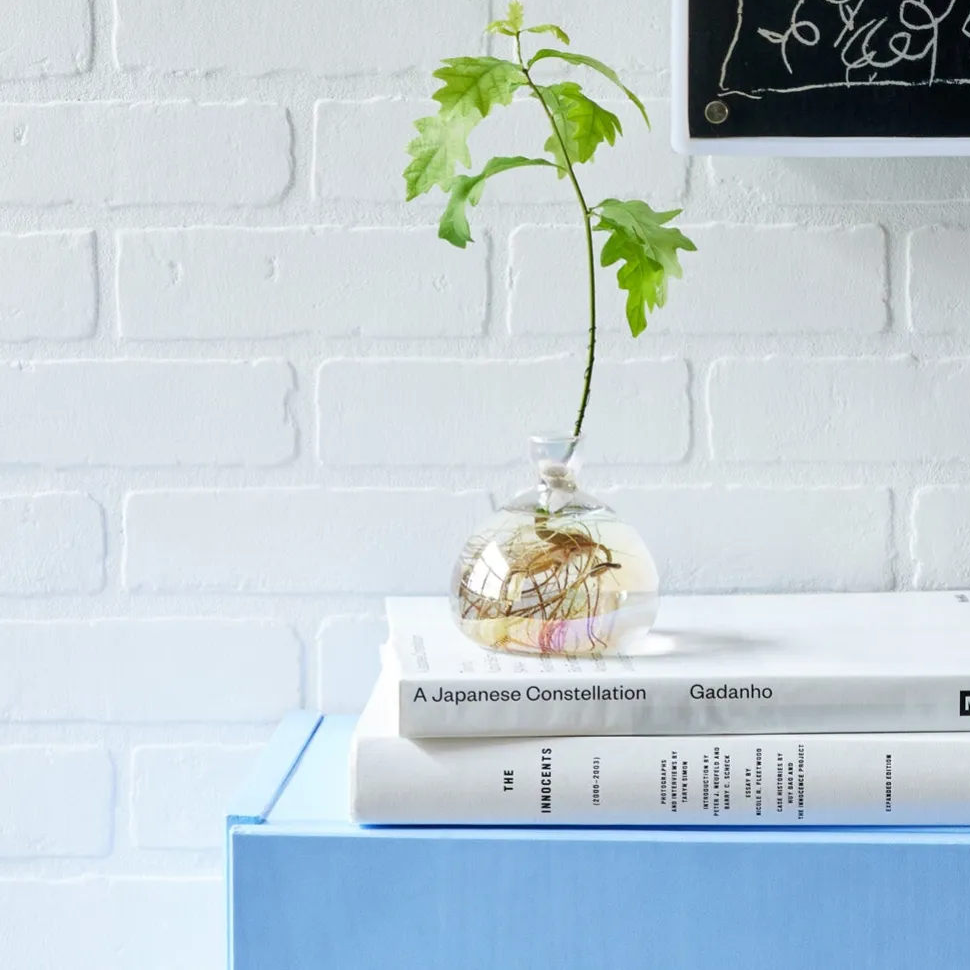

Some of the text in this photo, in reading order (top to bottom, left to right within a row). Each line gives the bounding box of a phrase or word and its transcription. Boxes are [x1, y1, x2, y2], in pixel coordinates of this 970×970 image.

[413, 685, 773, 705] A Japanese Constellation Gadanho
[671, 751, 677, 759] BY
[703, 755, 709, 763] BY
[777, 753, 783, 761] BY
[746, 768, 751, 776] BY
[504, 770, 514, 792] THE
[541, 748, 552, 813] INNOCENTS
